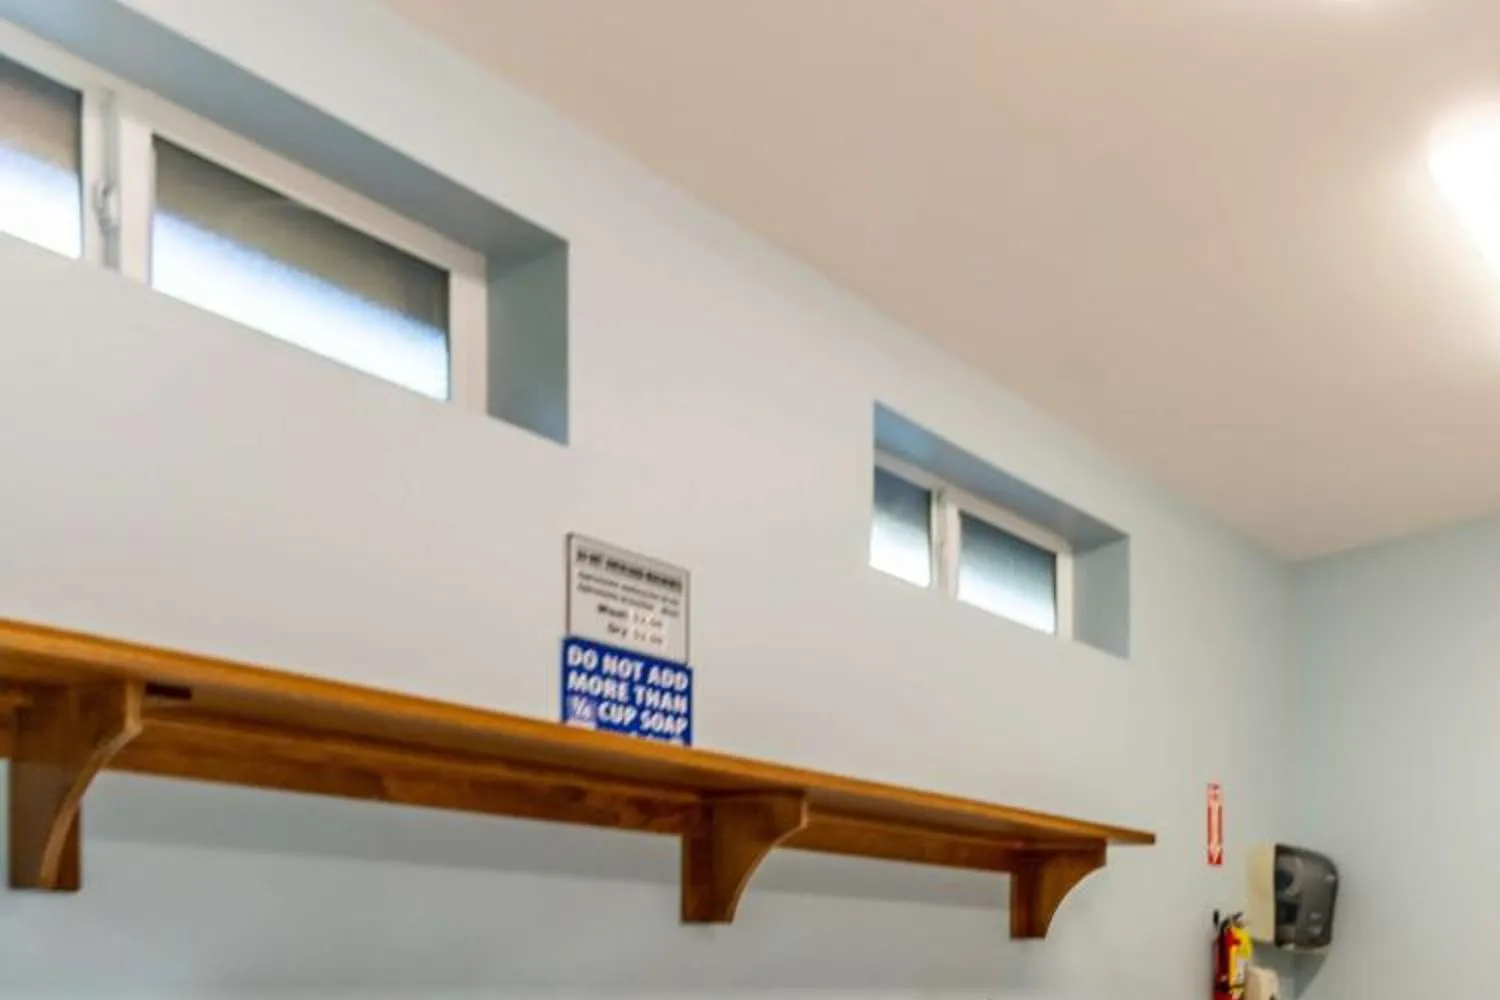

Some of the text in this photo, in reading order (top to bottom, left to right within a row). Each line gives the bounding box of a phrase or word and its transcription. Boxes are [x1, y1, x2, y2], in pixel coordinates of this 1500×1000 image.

[567, 644, 689, 691] DO NOT ADD
[567, 670, 689, 714] MORE THAN
[598, 701, 638, 727] CUP
[640, 709, 689, 734] SOAP
